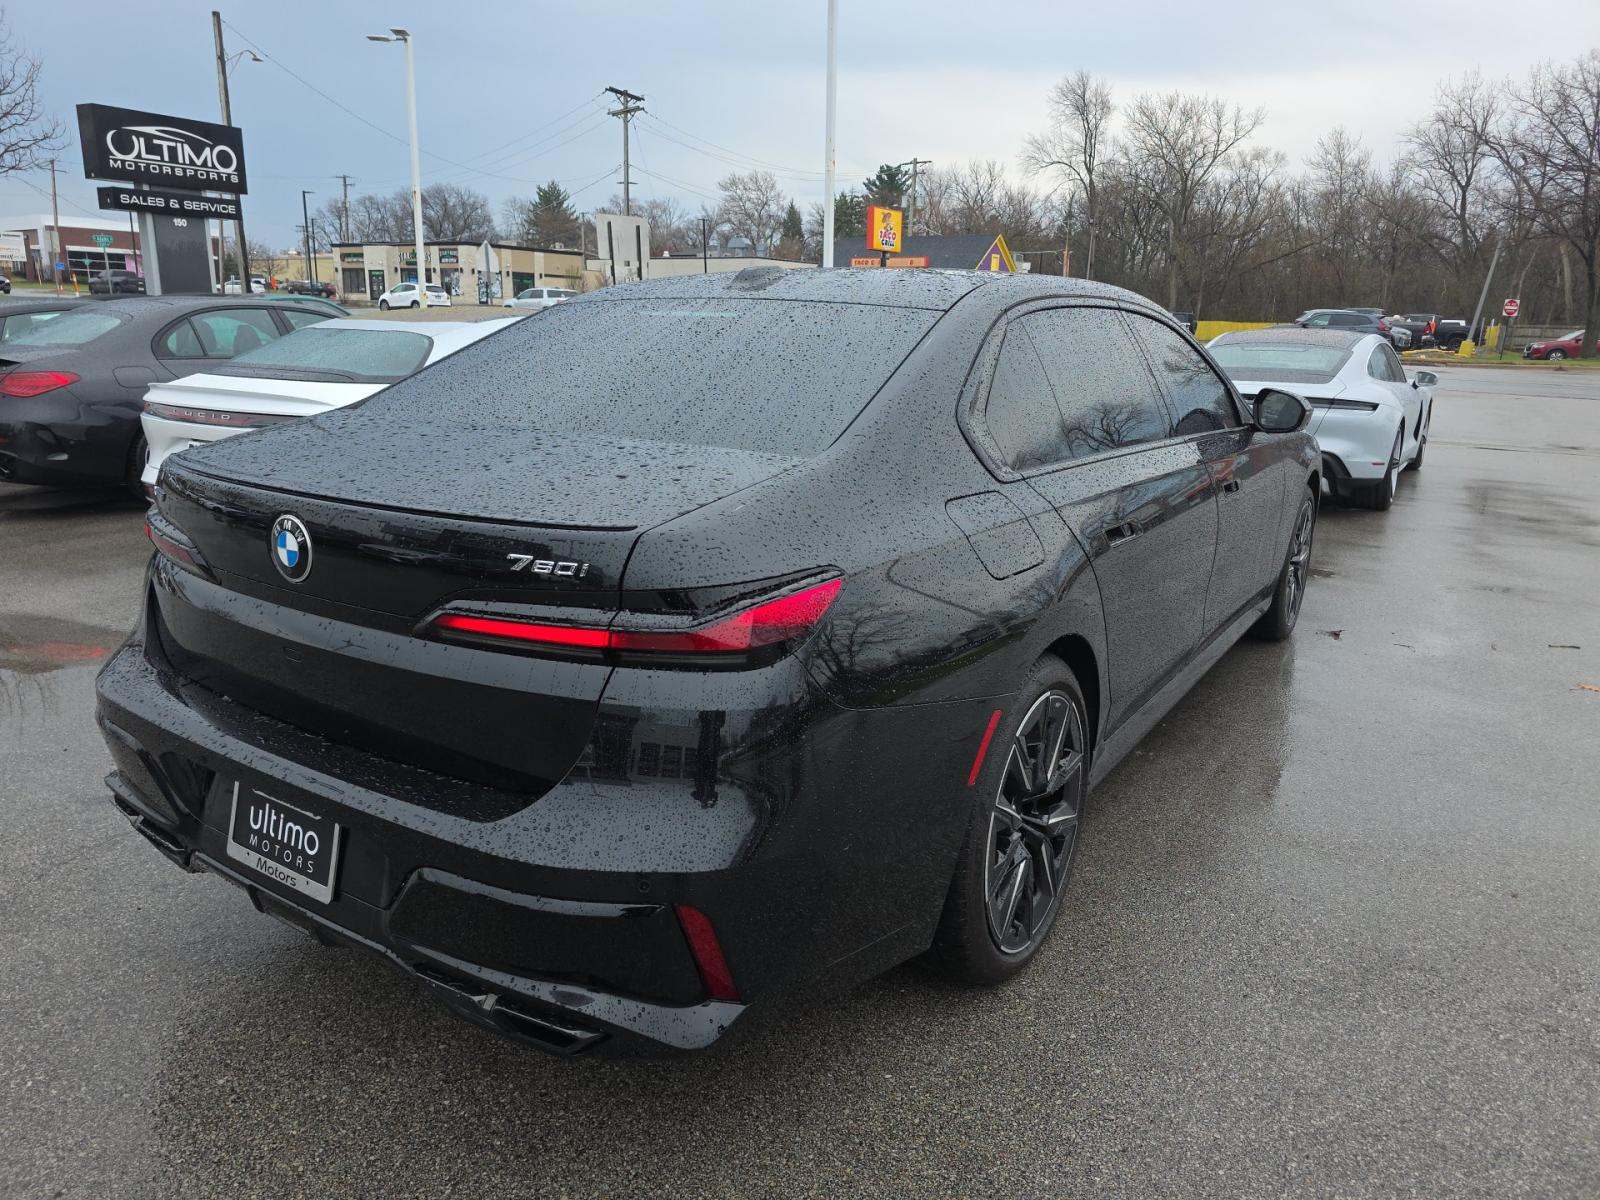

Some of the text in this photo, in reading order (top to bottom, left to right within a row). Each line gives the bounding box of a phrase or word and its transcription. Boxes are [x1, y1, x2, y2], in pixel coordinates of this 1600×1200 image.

[106, 129, 237, 173] ULTIMO
[109, 159, 239, 183] MOTORSPORTS
[120, 194, 236, 214] SALES & SERVICE
[506, 552, 591, 577] 760i
[249, 803, 319, 856] ultimo
[249, 834, 315, 873] MOTORS
[256, 857, 297, 887] Motors
